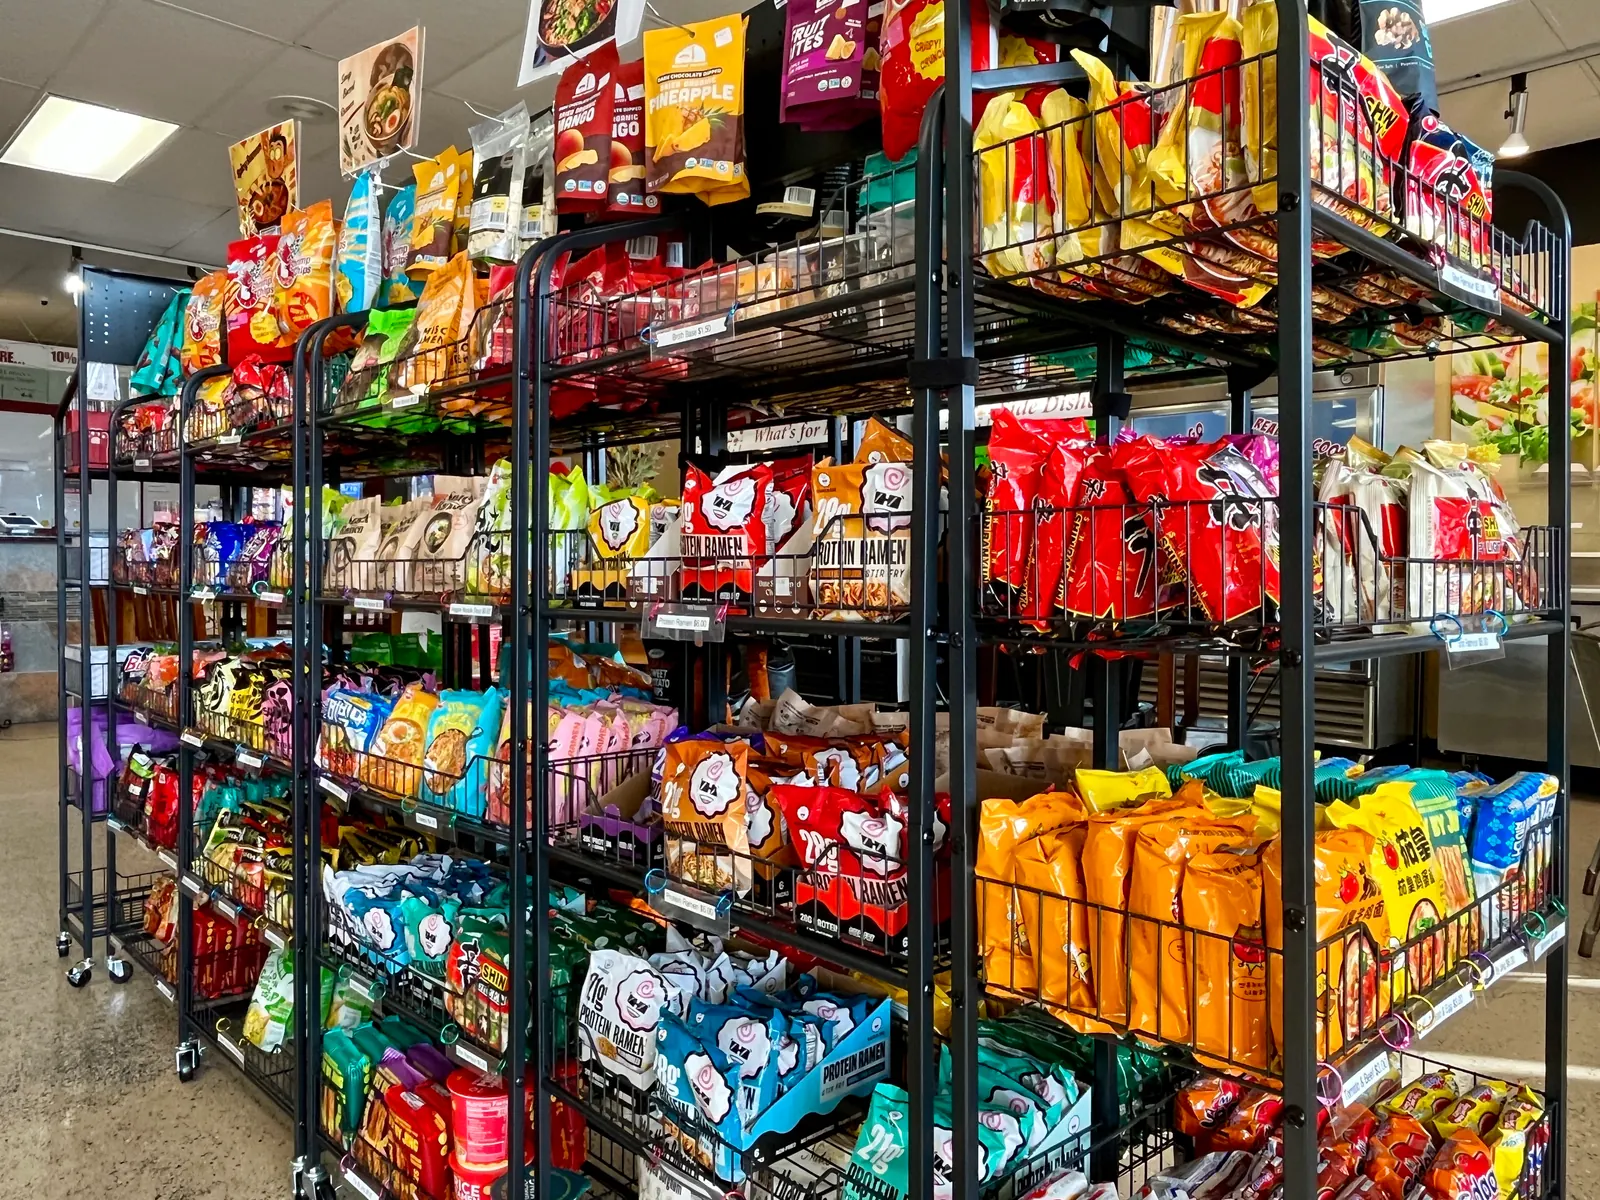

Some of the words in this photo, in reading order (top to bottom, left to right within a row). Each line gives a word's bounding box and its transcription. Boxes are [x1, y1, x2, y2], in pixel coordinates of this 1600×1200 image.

[671, 71, 702, 81] CHOCOLATE
[649, 83, 735, 115] PINEAPPLE
[672, 331, 684, 341] Broth
[685, 328, 697, 338] Base
[51, 350, 77, 365] 10%
[755, 423, 796, 443] What's
[797, 420, 822, 443] for
[704, 536, 743, 556] RAMEN
[567, 722, 581, 757] RAMEN
[778, 879, 785, 890] 6
[862, 878, 908, 906] RAMEN
[682, 898, 699, 910] Ramen
[816, 918, 839, 933] ROTEIN
[902, 936, 909, 947] 6
[482, 963, 507, 991] SHIN
[579, 1004, 613, 1037] PROTEIN
[612, 1024, 645, 1057] RAMEN
[653, 1047, 681, 1097] 8g
[823, 1052, 858, 1085] PROTEIN
[858, 1040, 886, 1069] RAMEN
[1364, 1067, 1375, 1085] Beef
